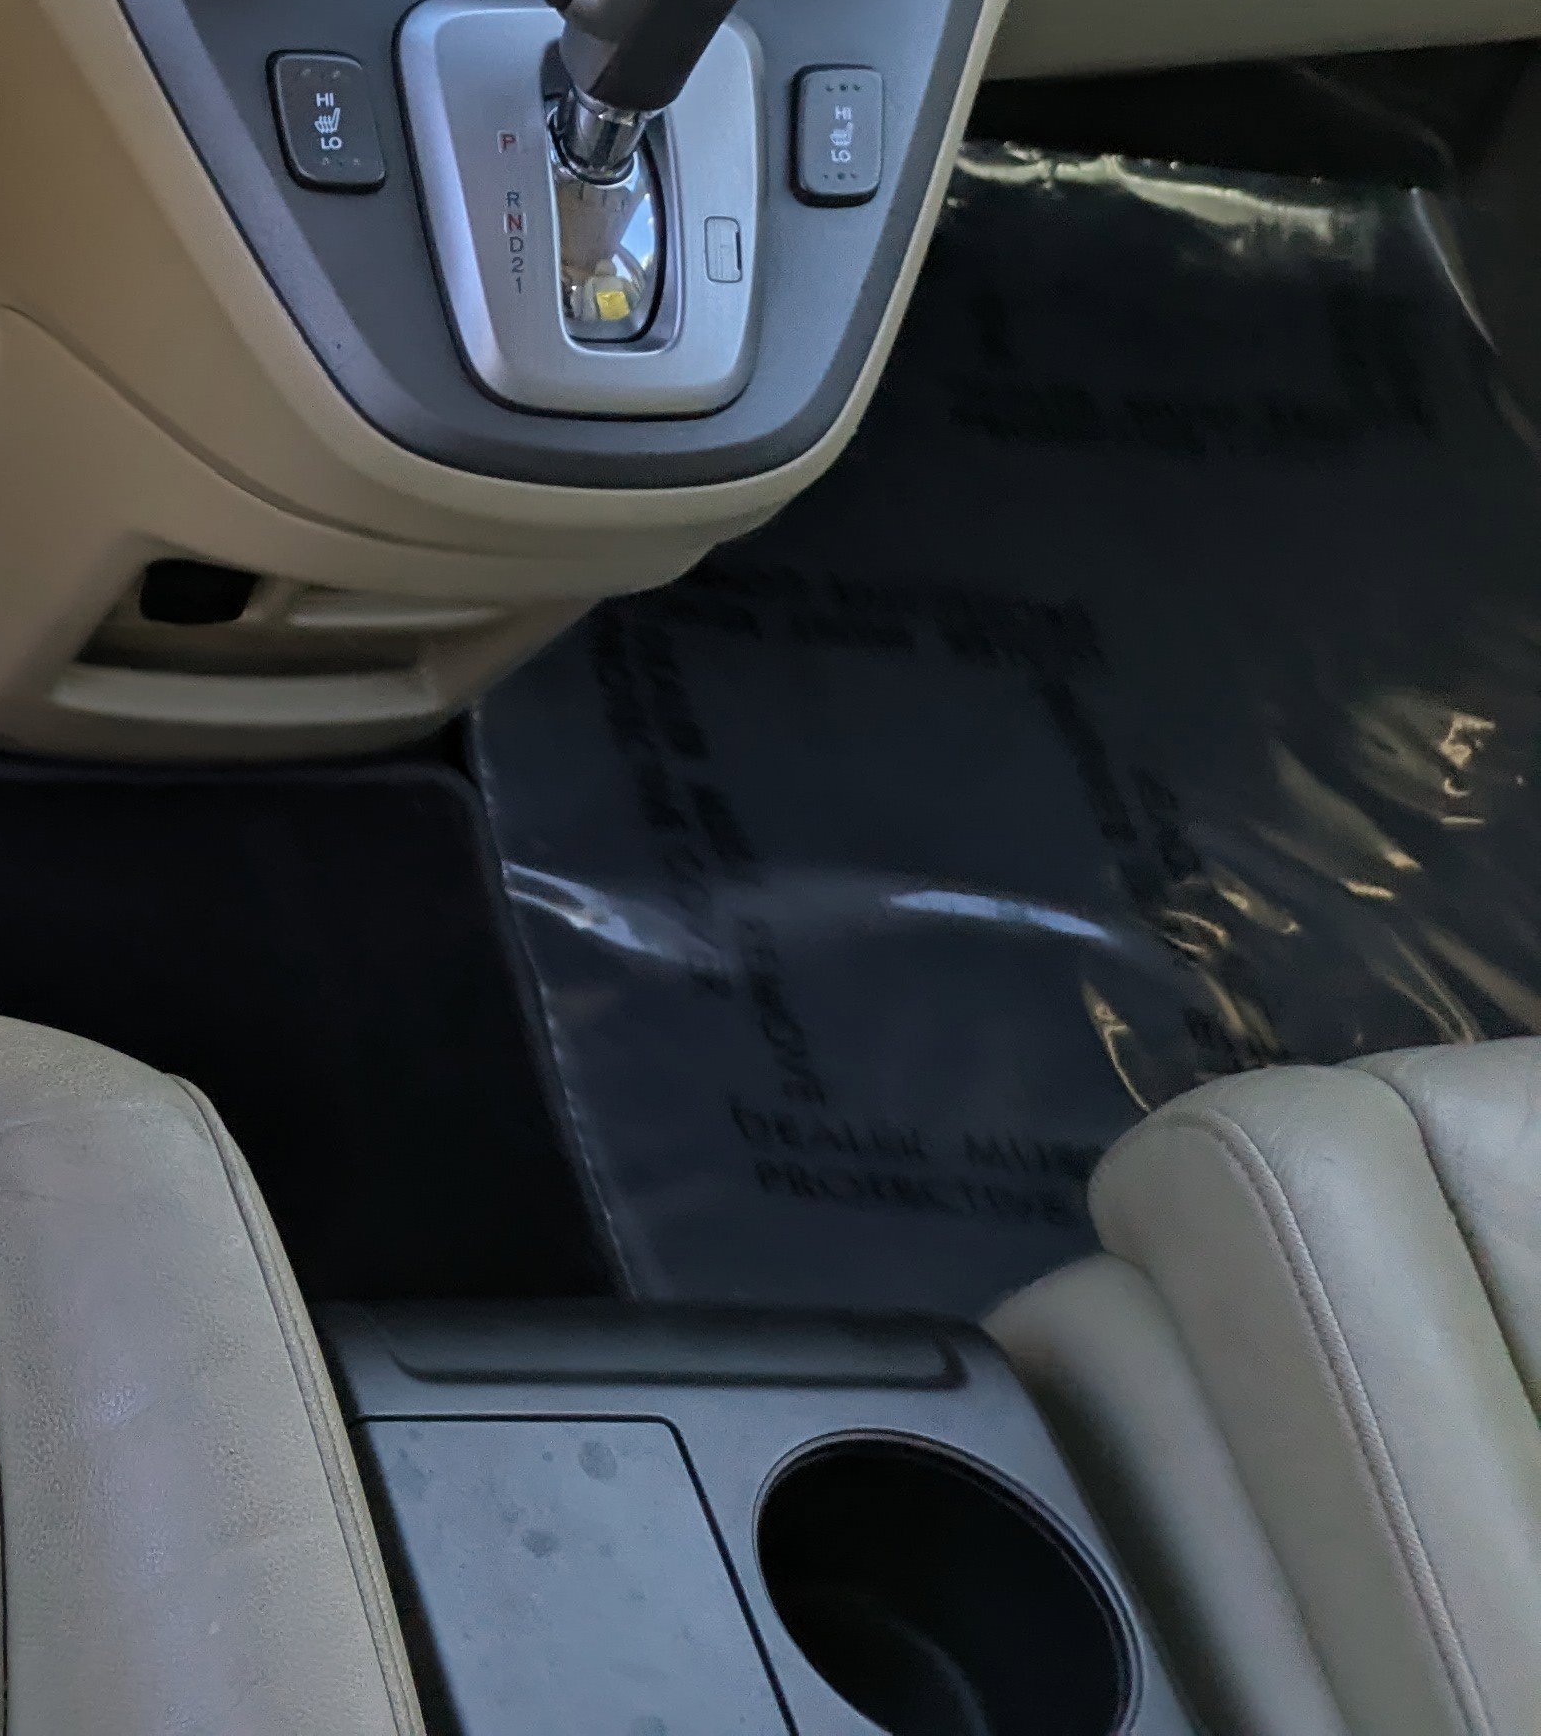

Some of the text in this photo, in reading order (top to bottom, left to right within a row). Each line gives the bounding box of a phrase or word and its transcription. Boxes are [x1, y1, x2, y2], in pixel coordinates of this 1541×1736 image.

[316, 92, 334, 107] HI
[320, 136, 342, 150] LO
[501, 132, 516, 152] P
[506, 191, 520, 207] R
[507, 213, 522, 232] N
[509, 236, 524, 253] D
[511, 256, 524, 273] 2
[516, 276, 523, 294] 1
